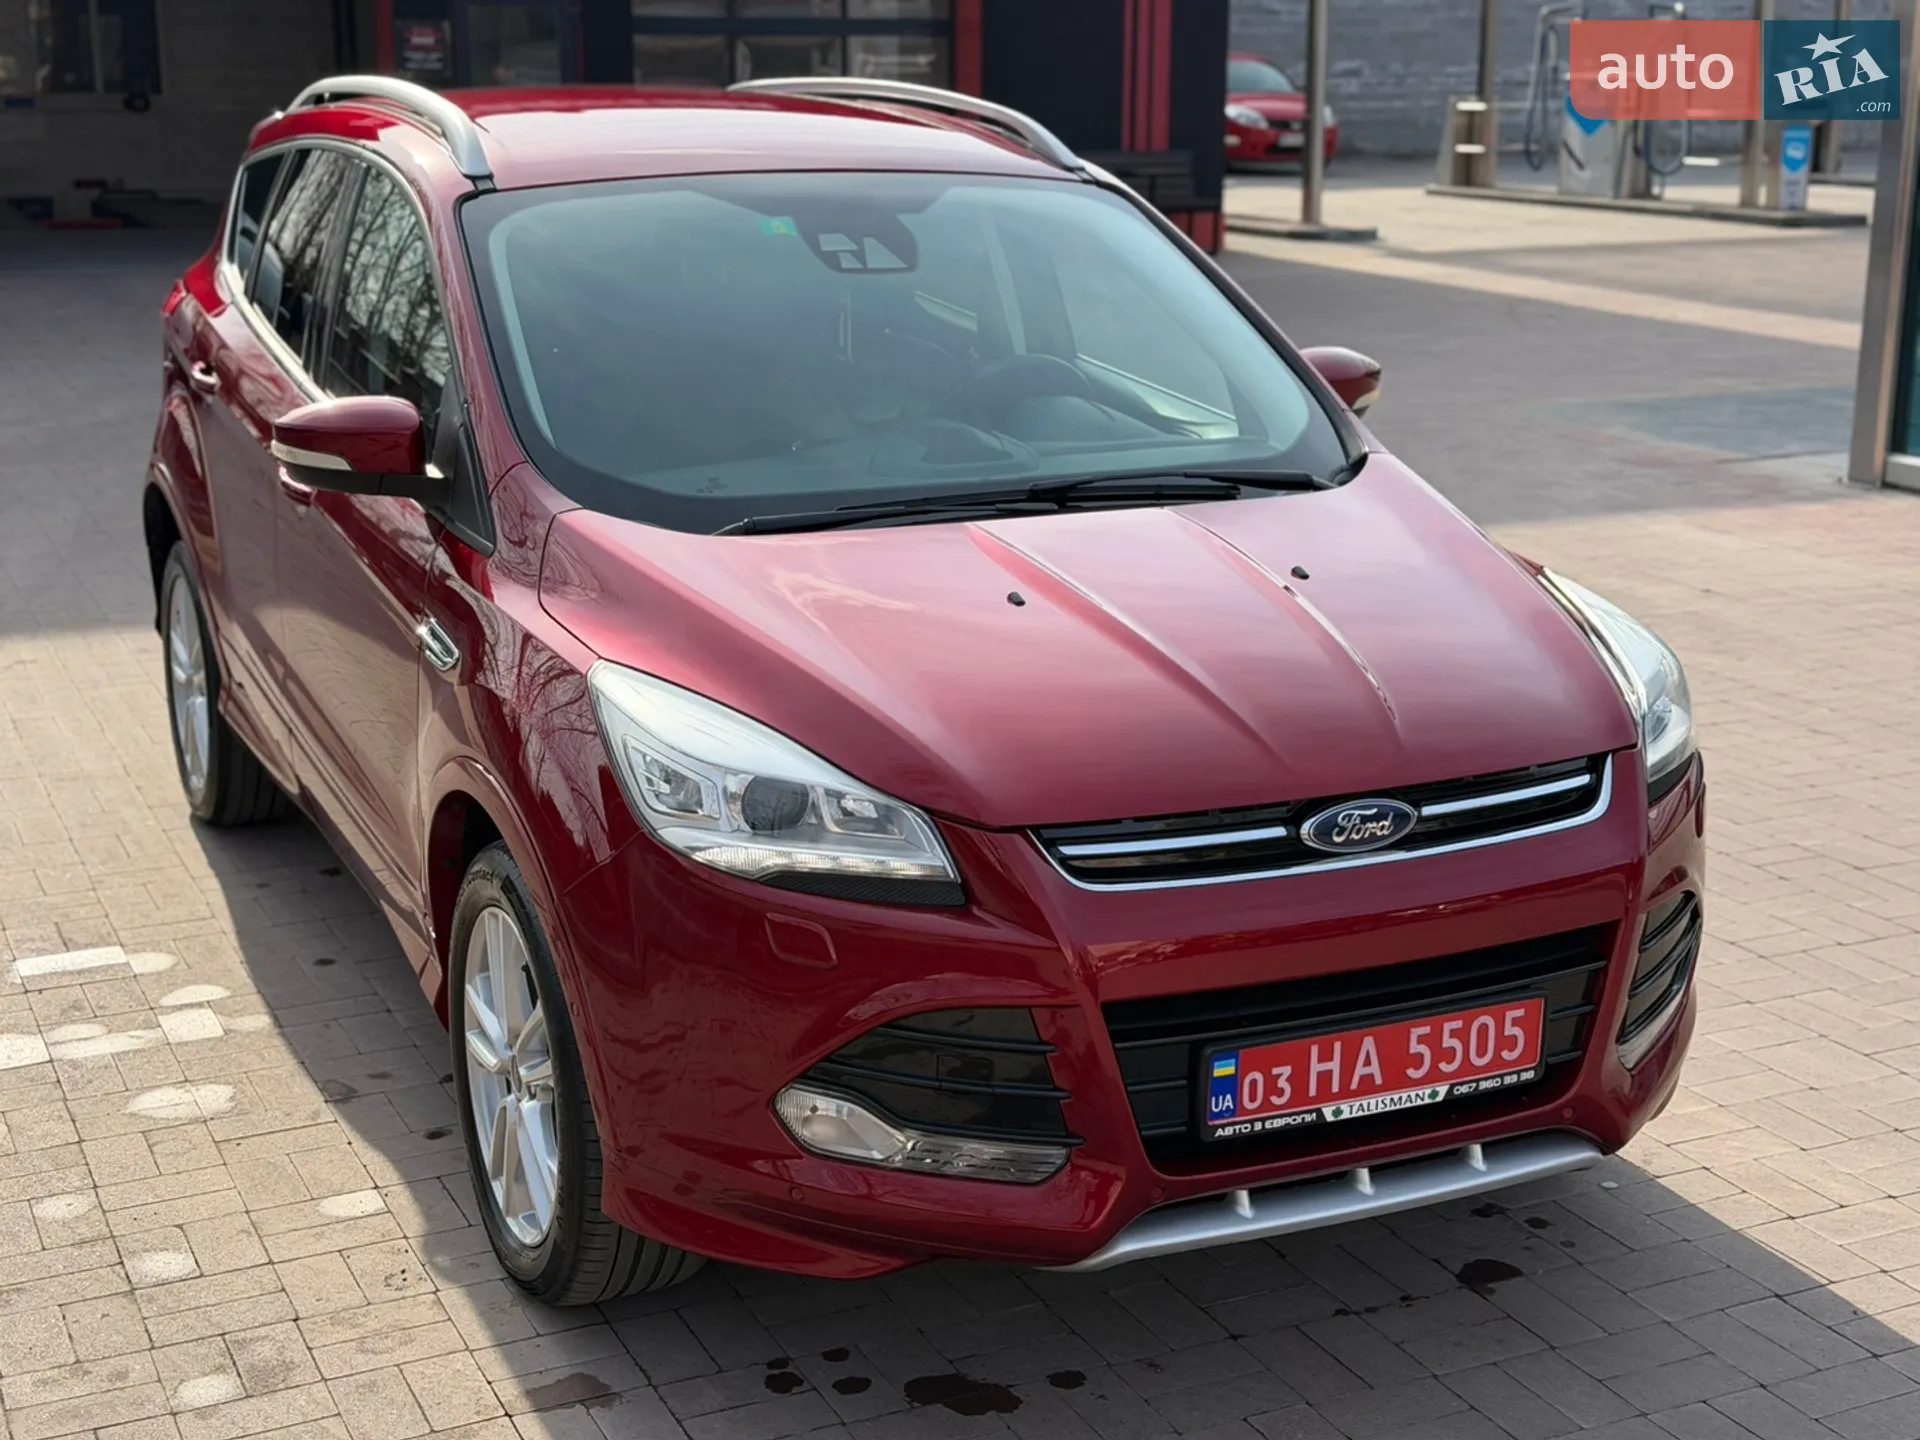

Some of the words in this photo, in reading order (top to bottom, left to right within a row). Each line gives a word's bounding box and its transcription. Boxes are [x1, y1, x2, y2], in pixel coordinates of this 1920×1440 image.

[1332, 808, 1394, 843] Ford
[1242, 1065, 1292, 1110] 03
[1405, 1008, 1525, 1079] 5505
[1453, 1083, 1477, 1095] 067
[1211, 1094, 1234, 1112] UA
[1348, 1091, 1426, 1116] TALISMAN
[1214, 1123, 1252, 1138] АВТО
